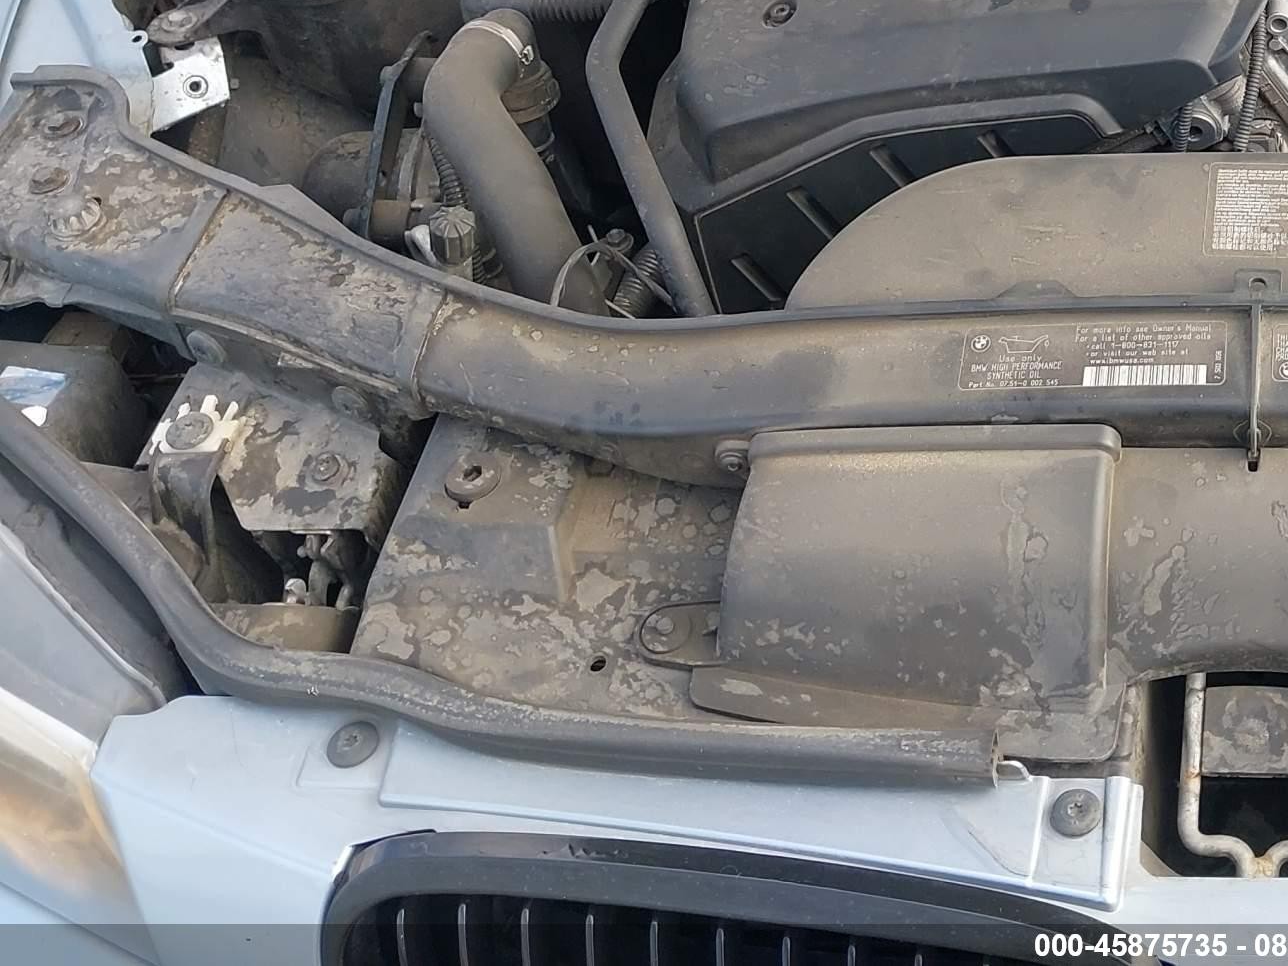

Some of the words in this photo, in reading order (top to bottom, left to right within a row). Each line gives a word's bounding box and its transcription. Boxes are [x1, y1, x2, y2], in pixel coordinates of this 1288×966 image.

[1076, 326, 1088, 334] For
[1116, 325, 1131, 333] info
[1153, 324, 1181, 332] Owner's
[1185, 324, 1211, 332] Manual
[1158, 332, 1191, 341] approved
[1195, 331, 1210, 340] oils
[1022, 354, 1042, 363] only
[971, 363, 988, 372] BMW
[991, 362, 1008, 371] HIGH
[1012, 361, 1062, 370] PERFORMANCE
[987, 370, 1025, 380] SYNTHETIC
[1030, 370, 1041, 378] OIL
